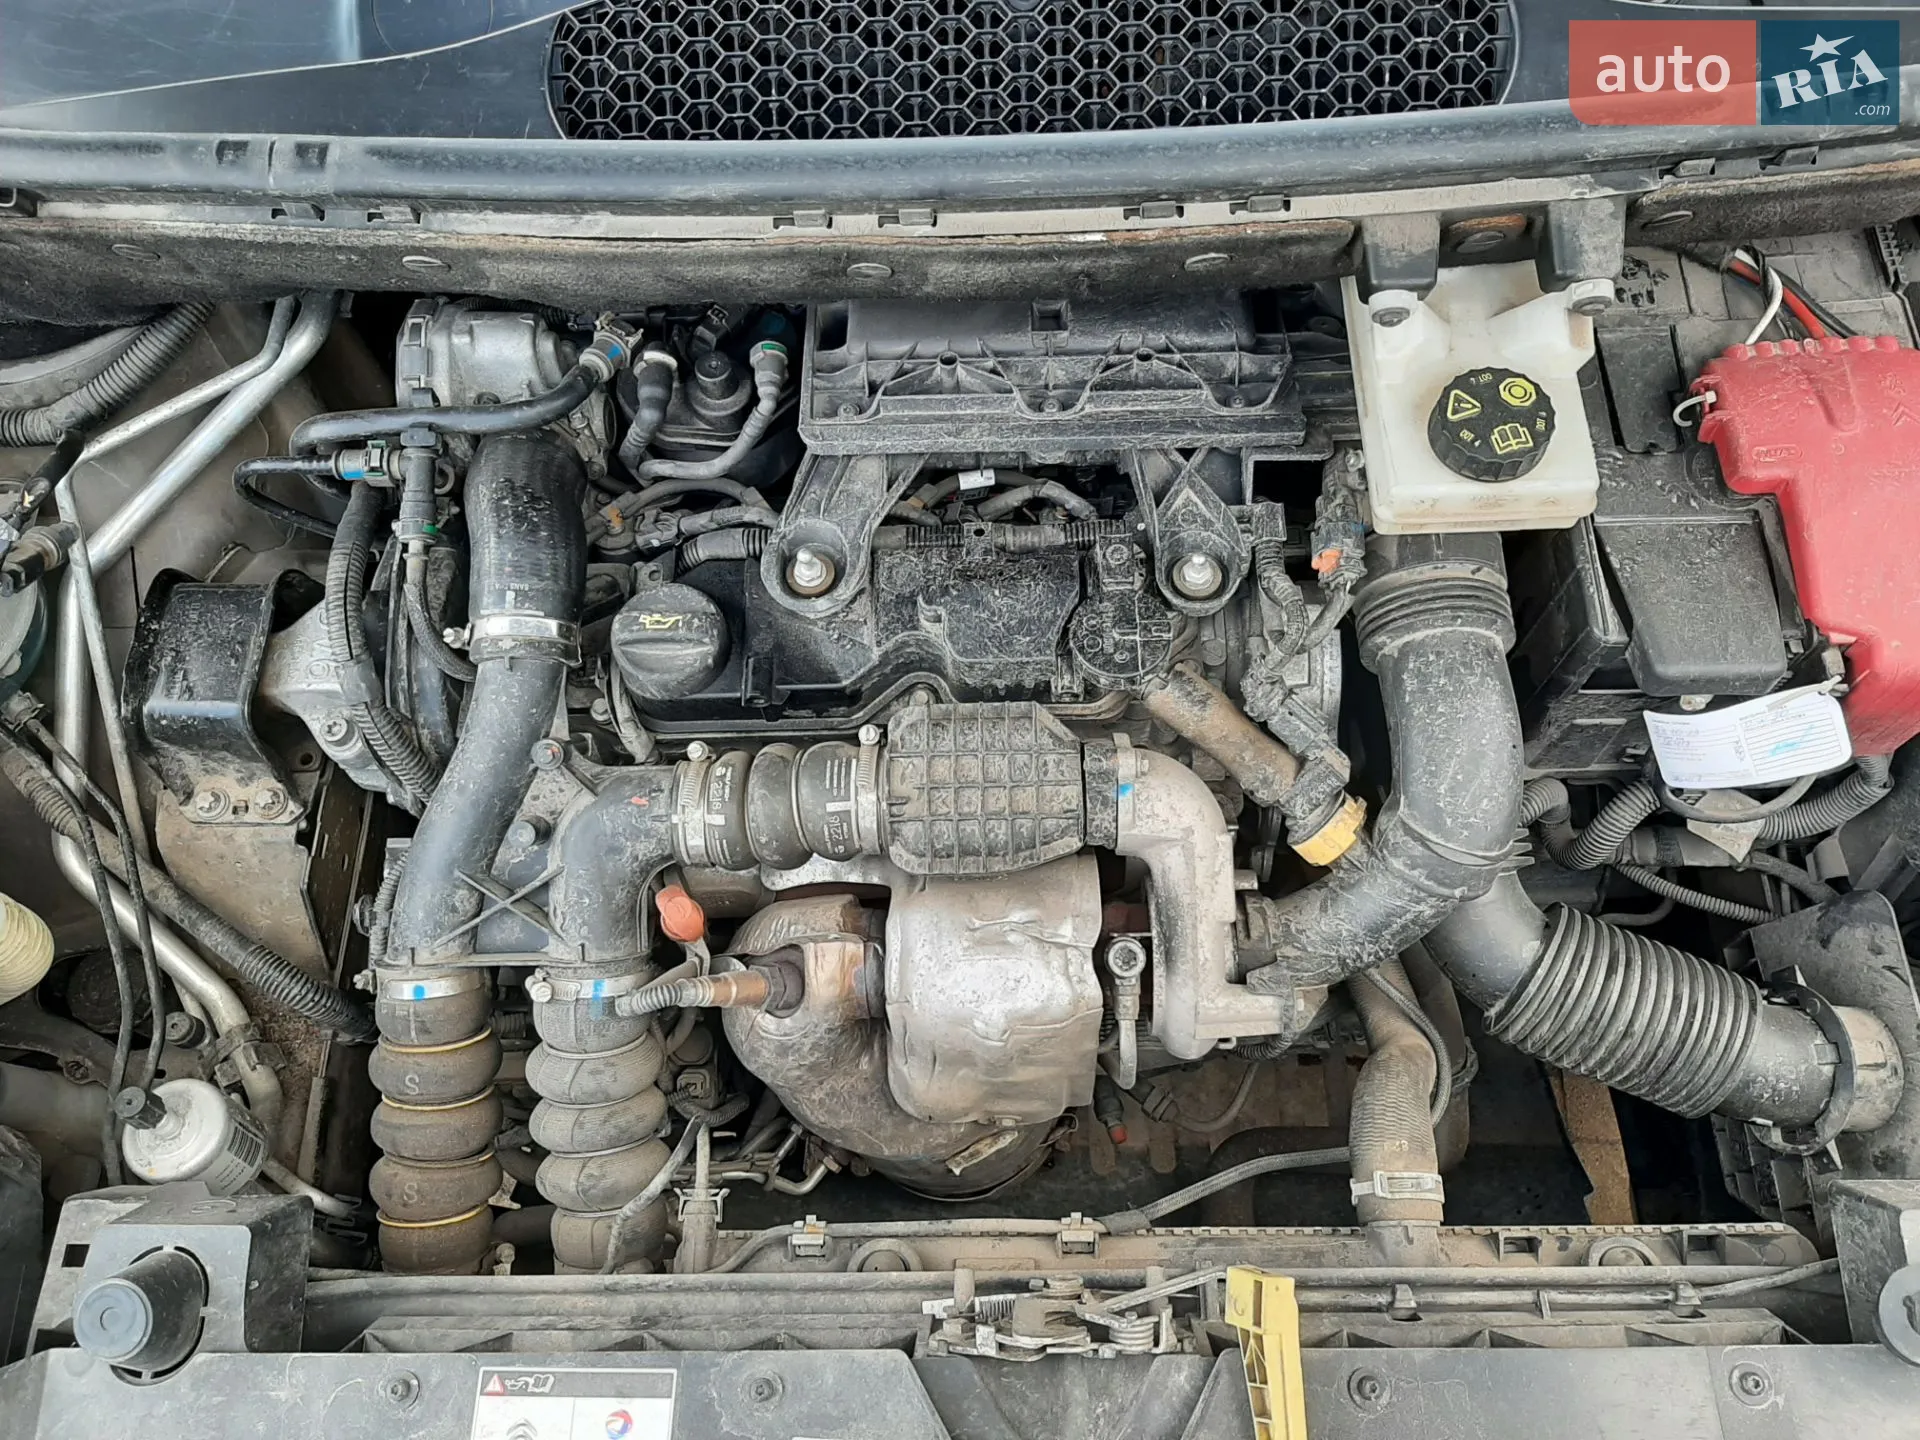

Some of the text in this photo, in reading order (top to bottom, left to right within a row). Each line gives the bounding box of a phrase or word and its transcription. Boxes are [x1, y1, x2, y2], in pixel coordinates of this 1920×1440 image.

[829, 815, 843, 841] 2218
[405, 1074, 419, 1095] S
[403, 1182, 418, 1203] S
